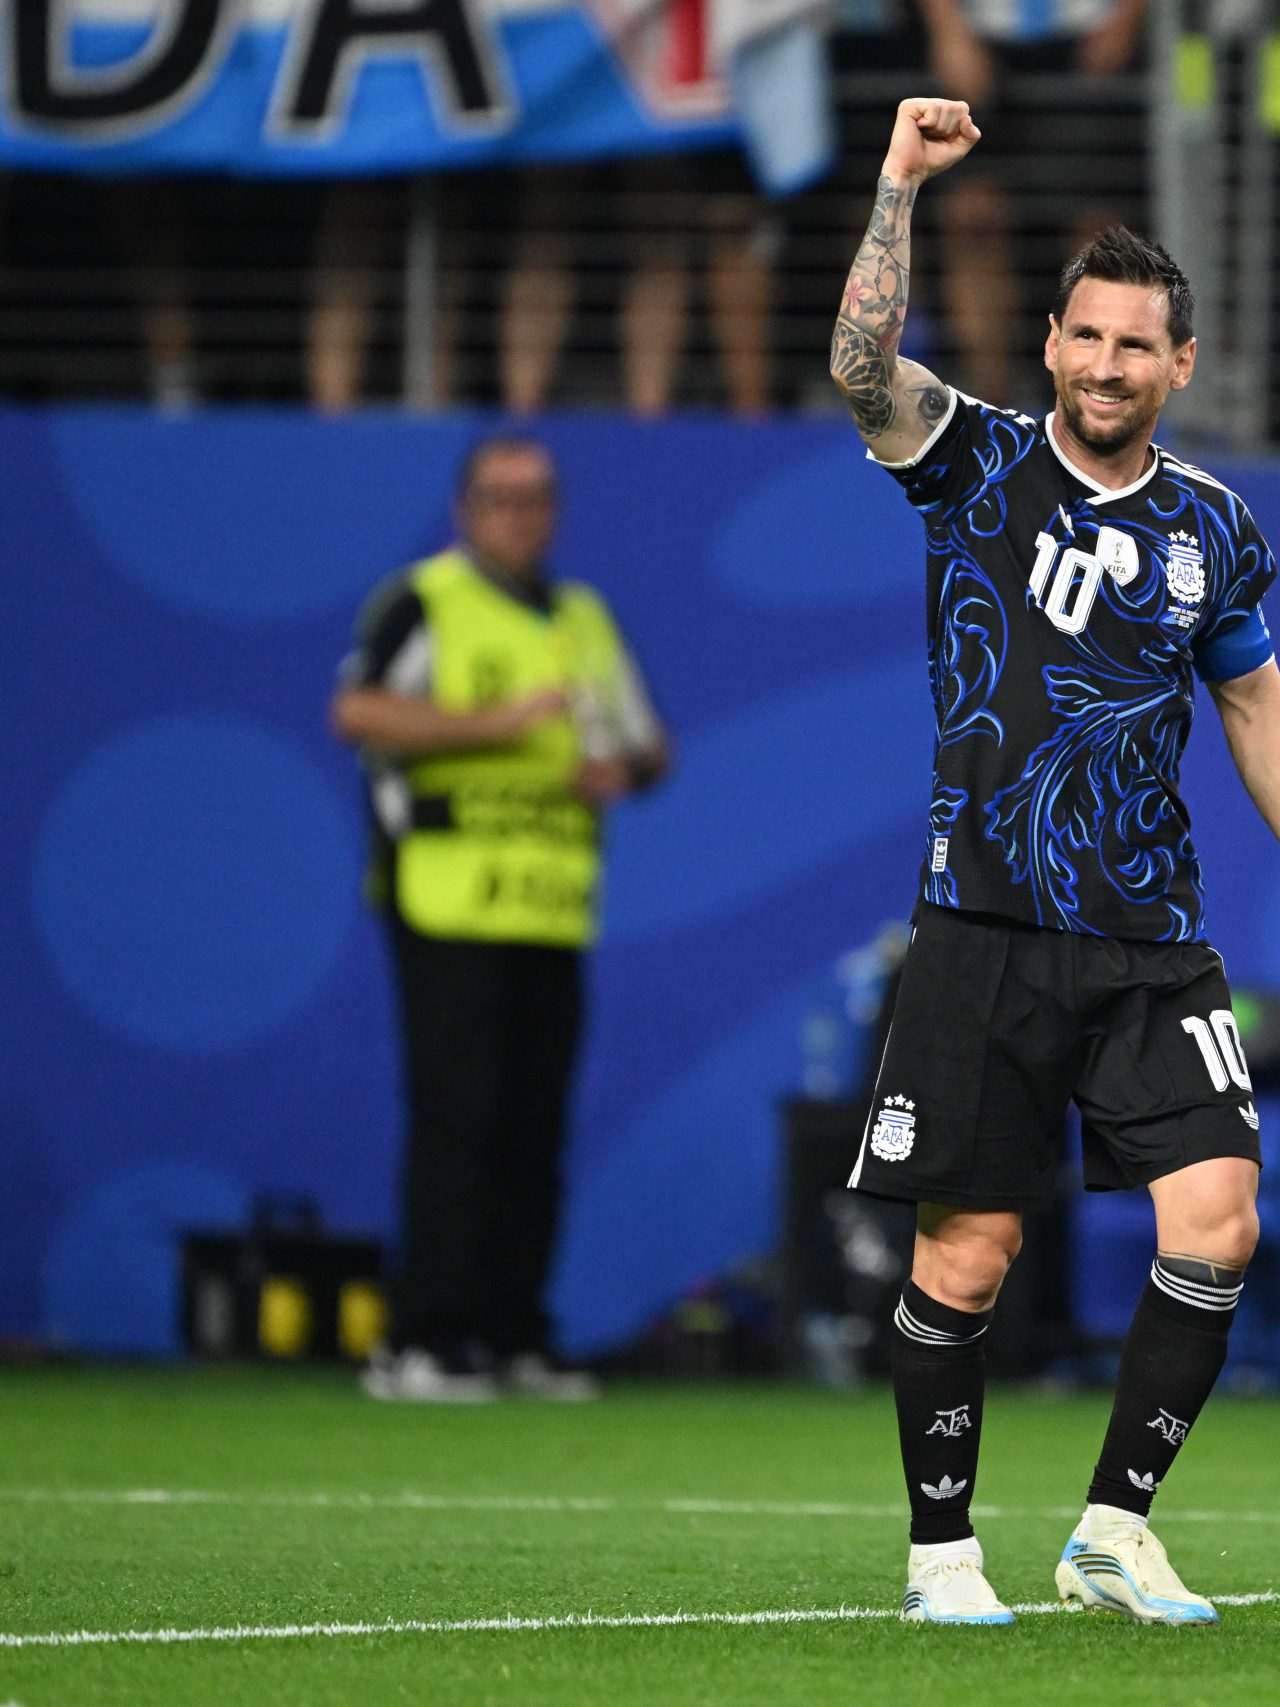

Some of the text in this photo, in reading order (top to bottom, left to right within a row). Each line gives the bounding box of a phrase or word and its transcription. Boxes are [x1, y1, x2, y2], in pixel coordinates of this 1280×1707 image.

[1029, 531, 1104, 635] 10
[1107, 565, 1127, 574] FIFA
[1176, 561, 1197, 587] AFA
[1181, 1010, 1253, 1092] 10
[881, 1123, 904, 1147] AFA
[926, 1404, 972, 1437] AFA
[1147, 1407, 1190, 1446] AFA
